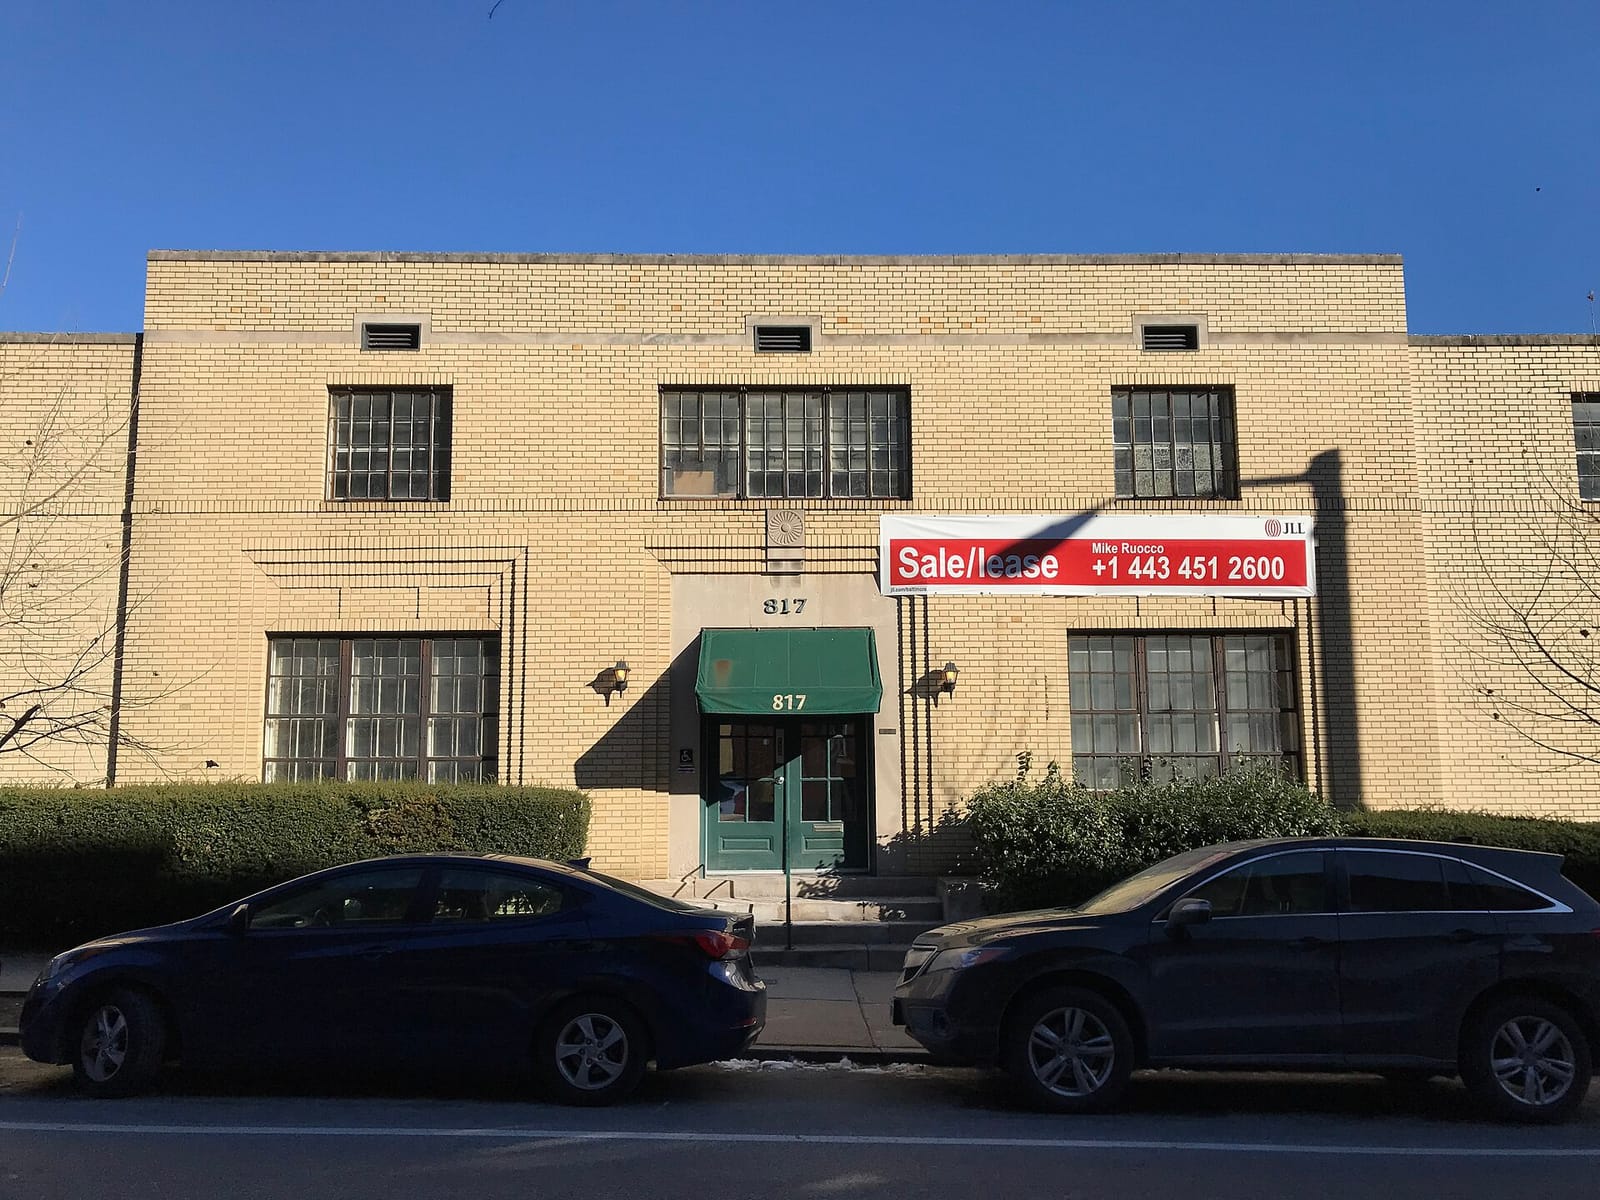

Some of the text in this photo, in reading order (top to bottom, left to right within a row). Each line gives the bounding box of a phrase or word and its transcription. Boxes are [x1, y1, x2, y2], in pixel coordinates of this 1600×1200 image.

[1282, 521, 1306, 535] JLL
[1092, 542, 1164, 555] Mike Ruocco
[898, 546, 1059, 578] Sale/lease
[1092, 556, 1286, 580] +1 443 451 2600
[763, 598, 807, 615] 817
[772, 694, 807, 711] 817
